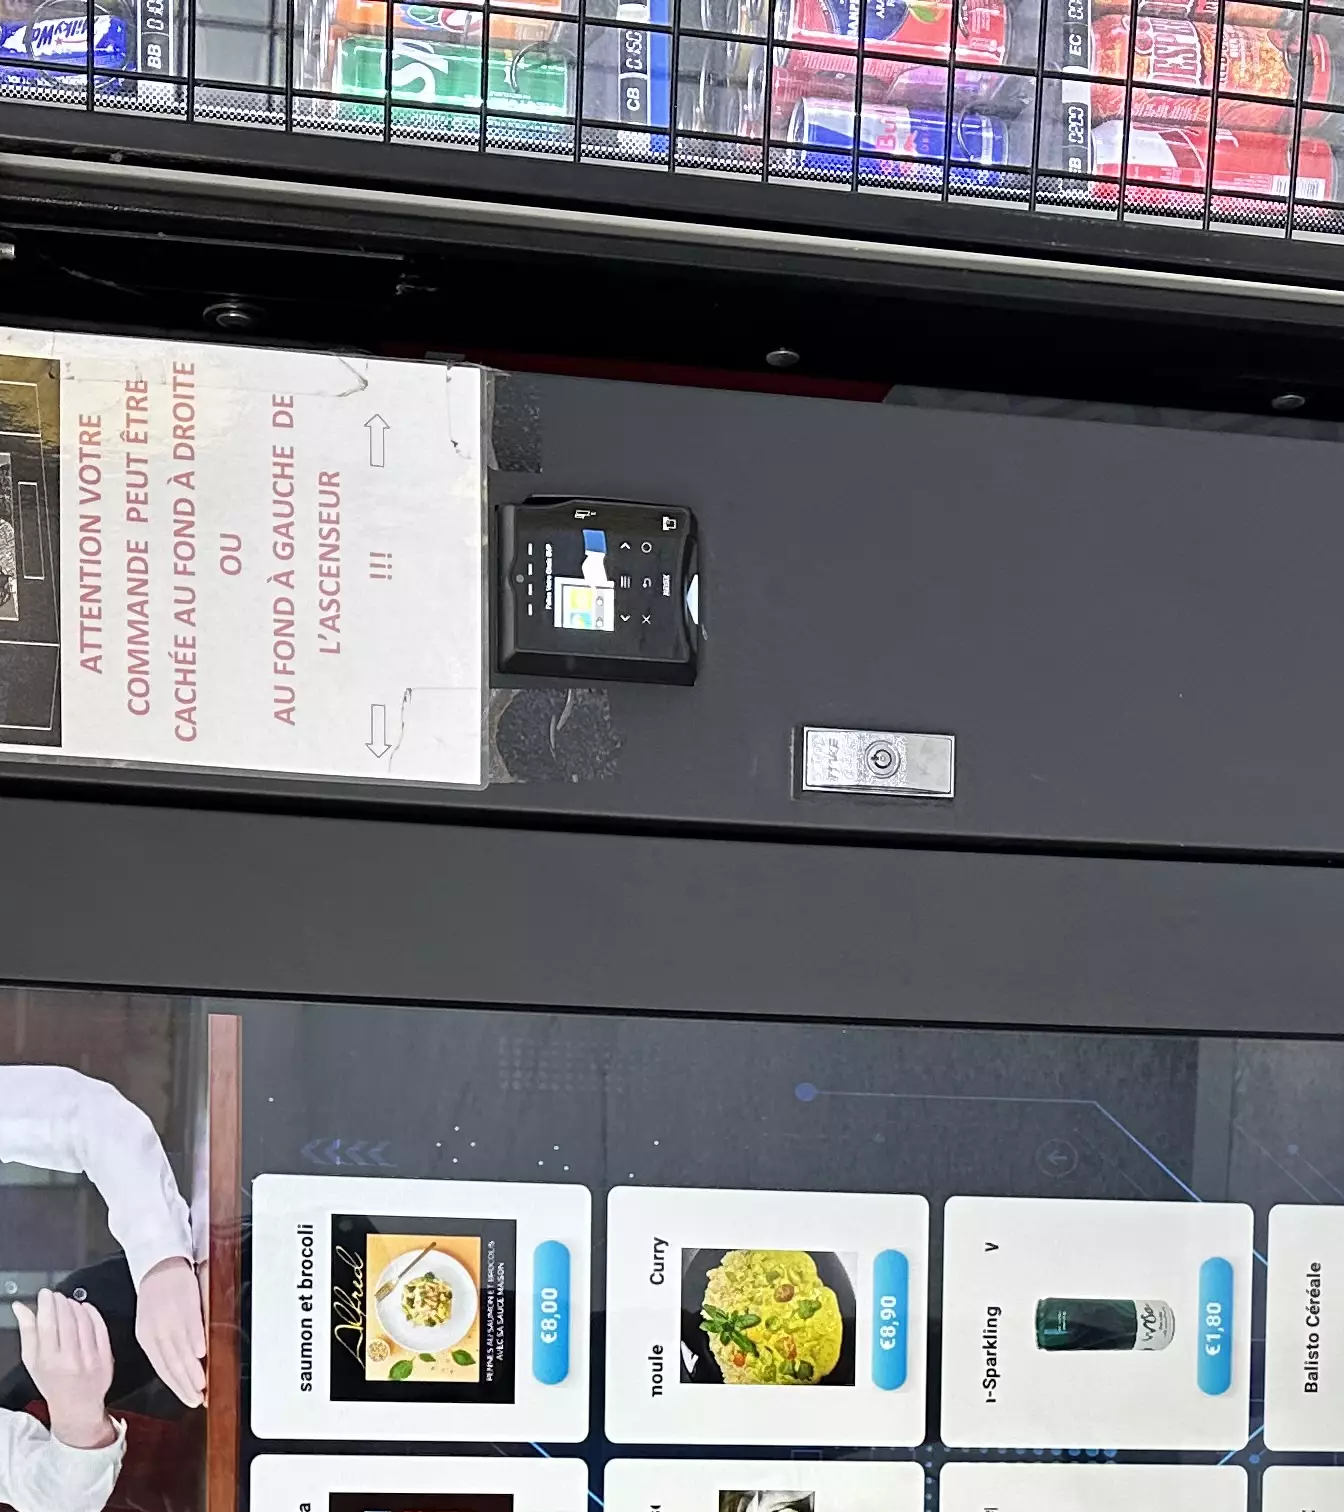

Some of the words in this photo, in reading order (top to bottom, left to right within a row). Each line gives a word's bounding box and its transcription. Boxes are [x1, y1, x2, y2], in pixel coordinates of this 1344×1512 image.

[147, 44, 162, 69] BB
[1068, 34, 1082, 56] EC
[626, 87, 640, 111] CB
[120, 379, 149, 444] ÊTRE
[172, 361, 196, 461] DROITE
[272, 394, 294, 429] DE
[78, 413, 102, 505] VOTRE
[126, 452, 149, 523] PEUT
[167, 470, 196, 490] À
[271, 445, 294, 561] GAUCHE
[172, 498, 196, 577] FOND
[219, 533, 242, 576] OU
[369, 551, 393, 580] !!!
[79, 514, 103, 674] ATTENTION
[173, 585, 196, 627] AU
[267, 569, 295, 589] À
[126, 539, 151, 716] COMMANDE
[272, 597, 295, 676] FOND
[168, 635, 197, 743] CACHÉE
[272, 685, 296, 726] AU
[297, 1223, 315, 1289] brocoli
[649, 1237, 669, 1285] Curry
[299, 1294, 314, 1312] et
[540, 1287, 561, 1344] €8,00
[880, 1295, 899, 1350] €8,90
[1304, 1262, 1323, 1327] Céréale
[299, 1317, 313, 1392] saumon
[1204, 1302, 1223, 1356] €1,80
[1304, 1332, 1321, 1393] Balisto
